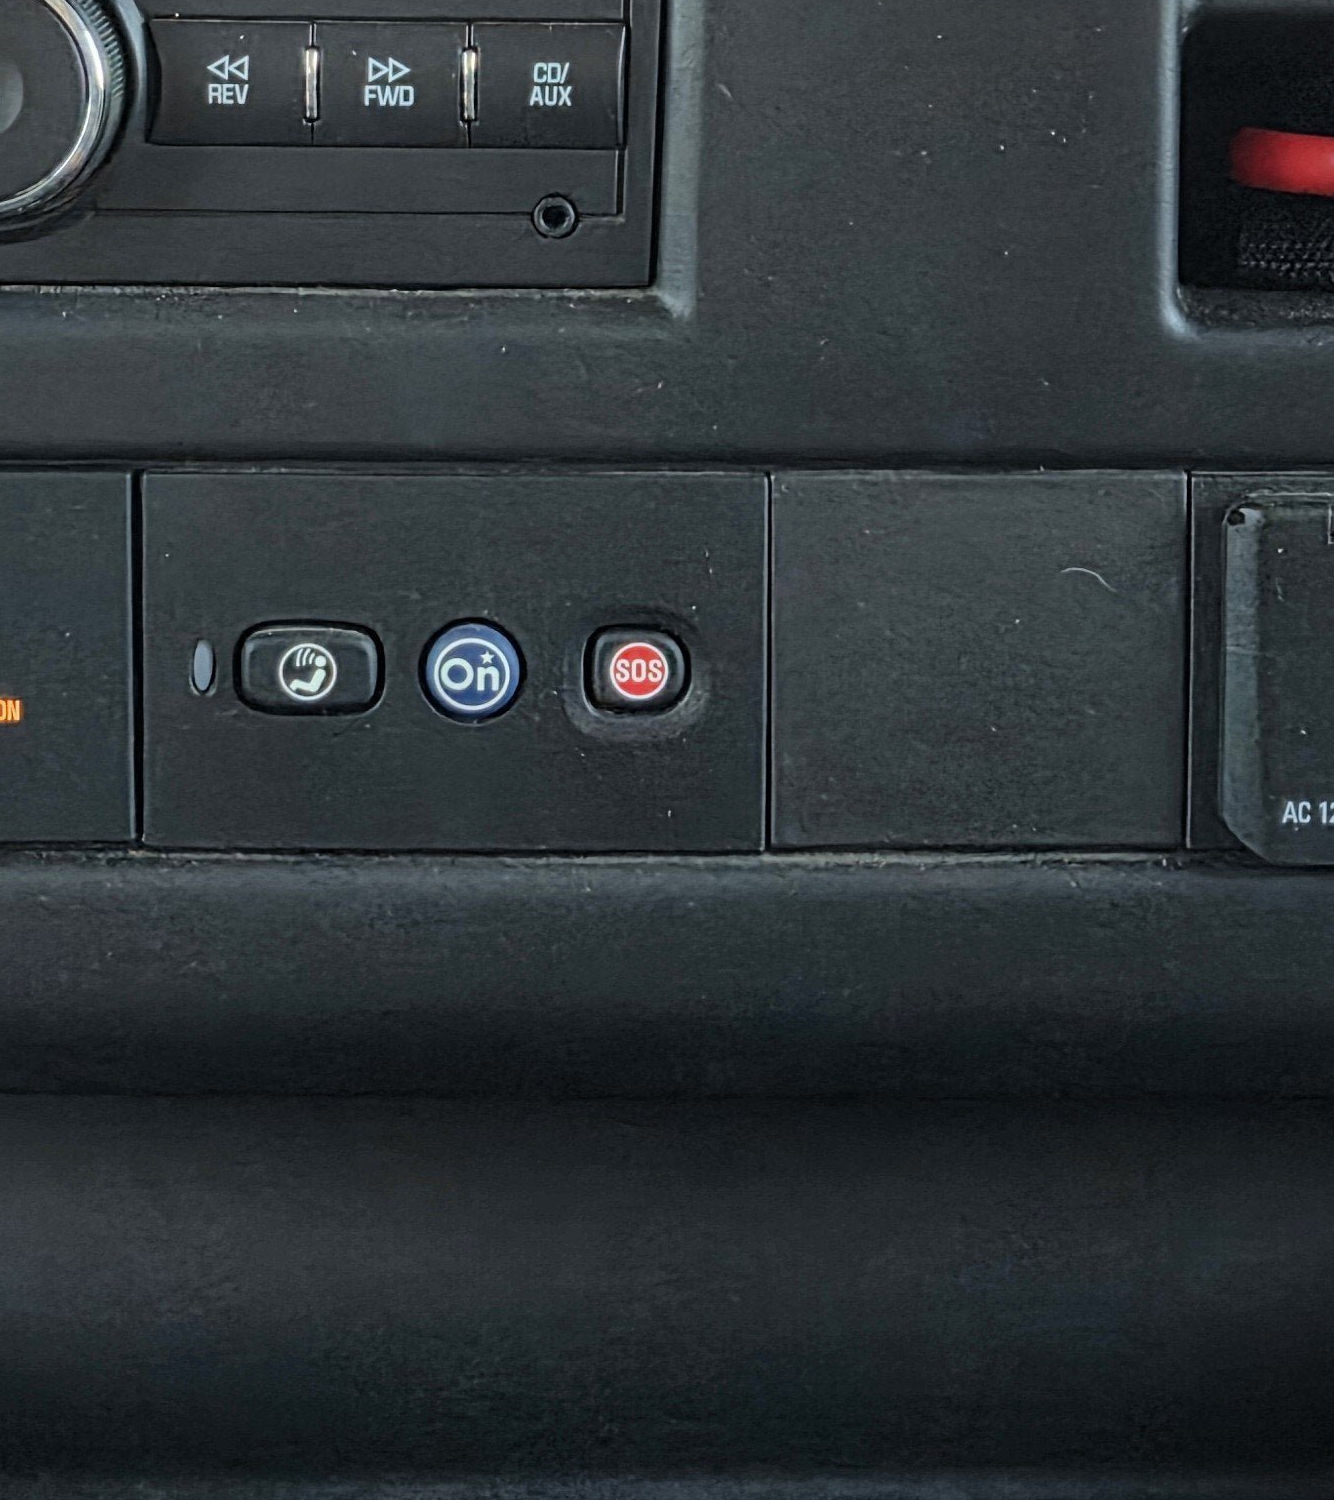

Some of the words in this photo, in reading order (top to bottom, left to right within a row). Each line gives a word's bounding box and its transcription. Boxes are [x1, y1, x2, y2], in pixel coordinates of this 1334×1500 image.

[533, 62, 570, 84] CD/
[208, 83, 249, 105] REV
[363, 84, 415, 107] FWD
[529, 85, 572, 107] AUX
[440, 658, 501, 691] On
[616, 659, 664, 683] SOS
[1282, 800, 1311, 824] AC
